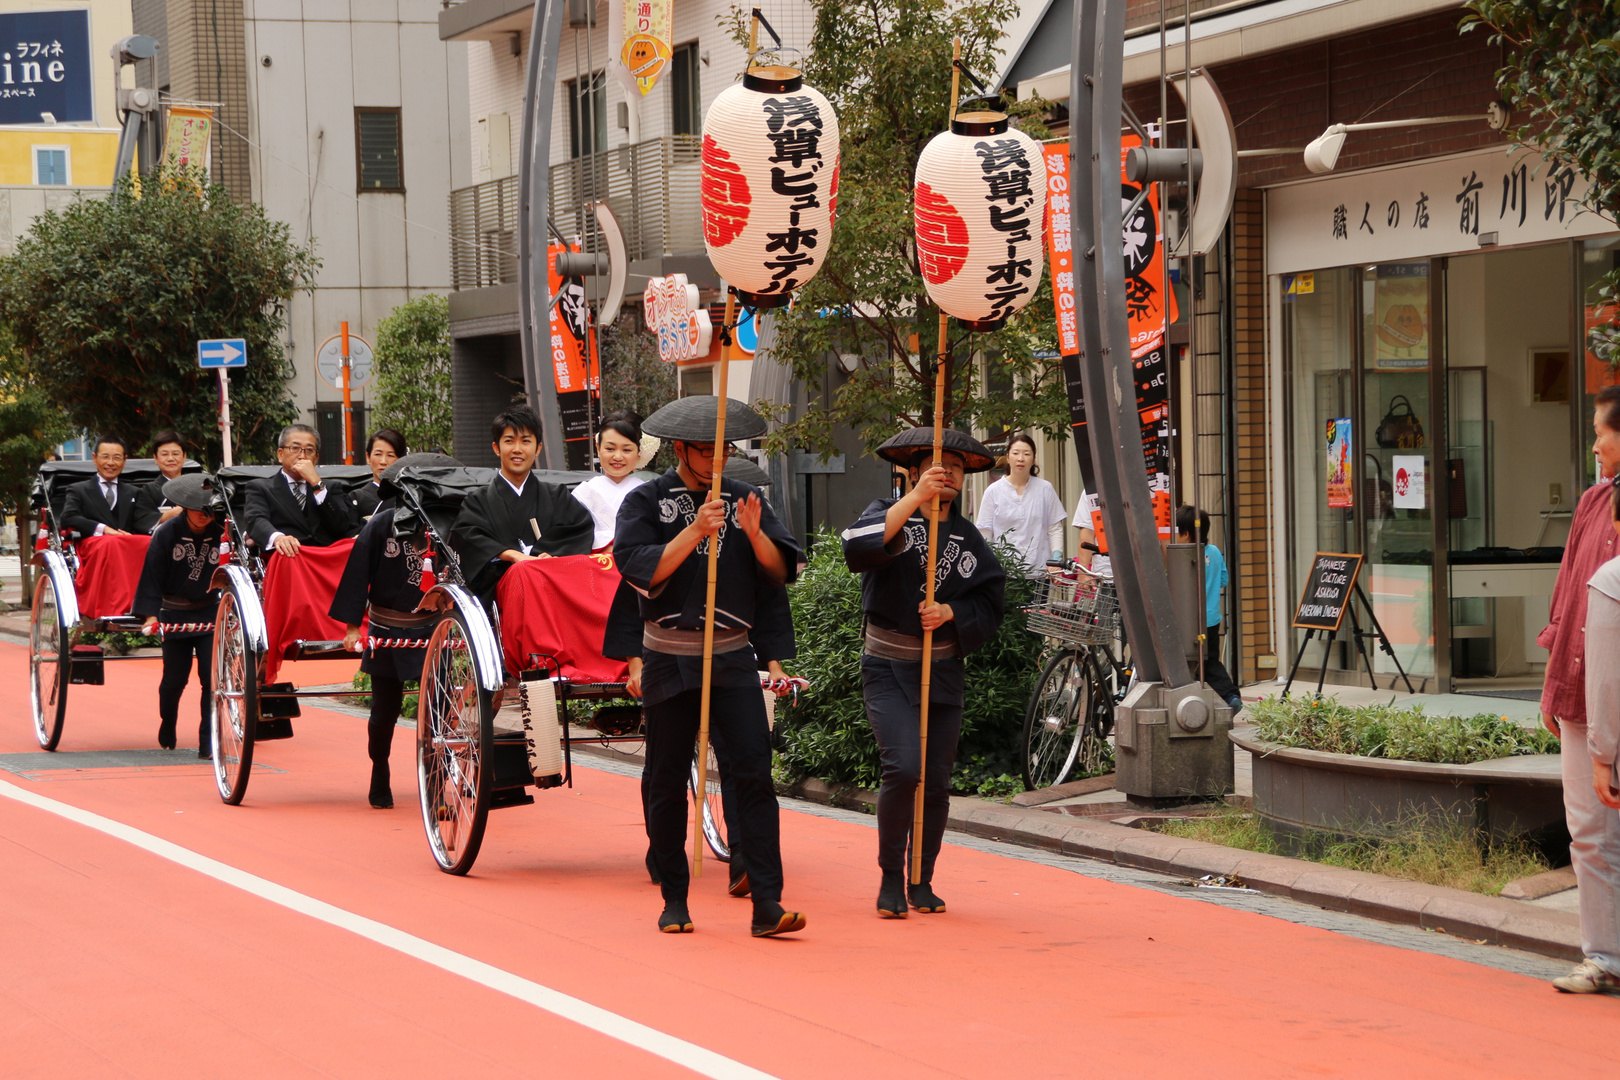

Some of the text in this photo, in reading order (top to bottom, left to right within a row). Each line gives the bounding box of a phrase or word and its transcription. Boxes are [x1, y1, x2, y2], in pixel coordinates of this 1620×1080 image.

[637, 2, 651, 33] 通り
[17, 40, 64, 58] ラフィネ
[2, 52, 65, 84] ine
[0, 88, 36, 99] スペース
[179, 118, 194, 172] オレンジ通
[757, 96, 823, 294] 浅草ビューホテル
[1333, 162, 1602, 240] 職人の店 前川印
[974, 138, 1034, 321] 浅草ビューホテル
[660, 316, 687, 354] おうち
[1316, 558, 1347, 571] JAPANESE
